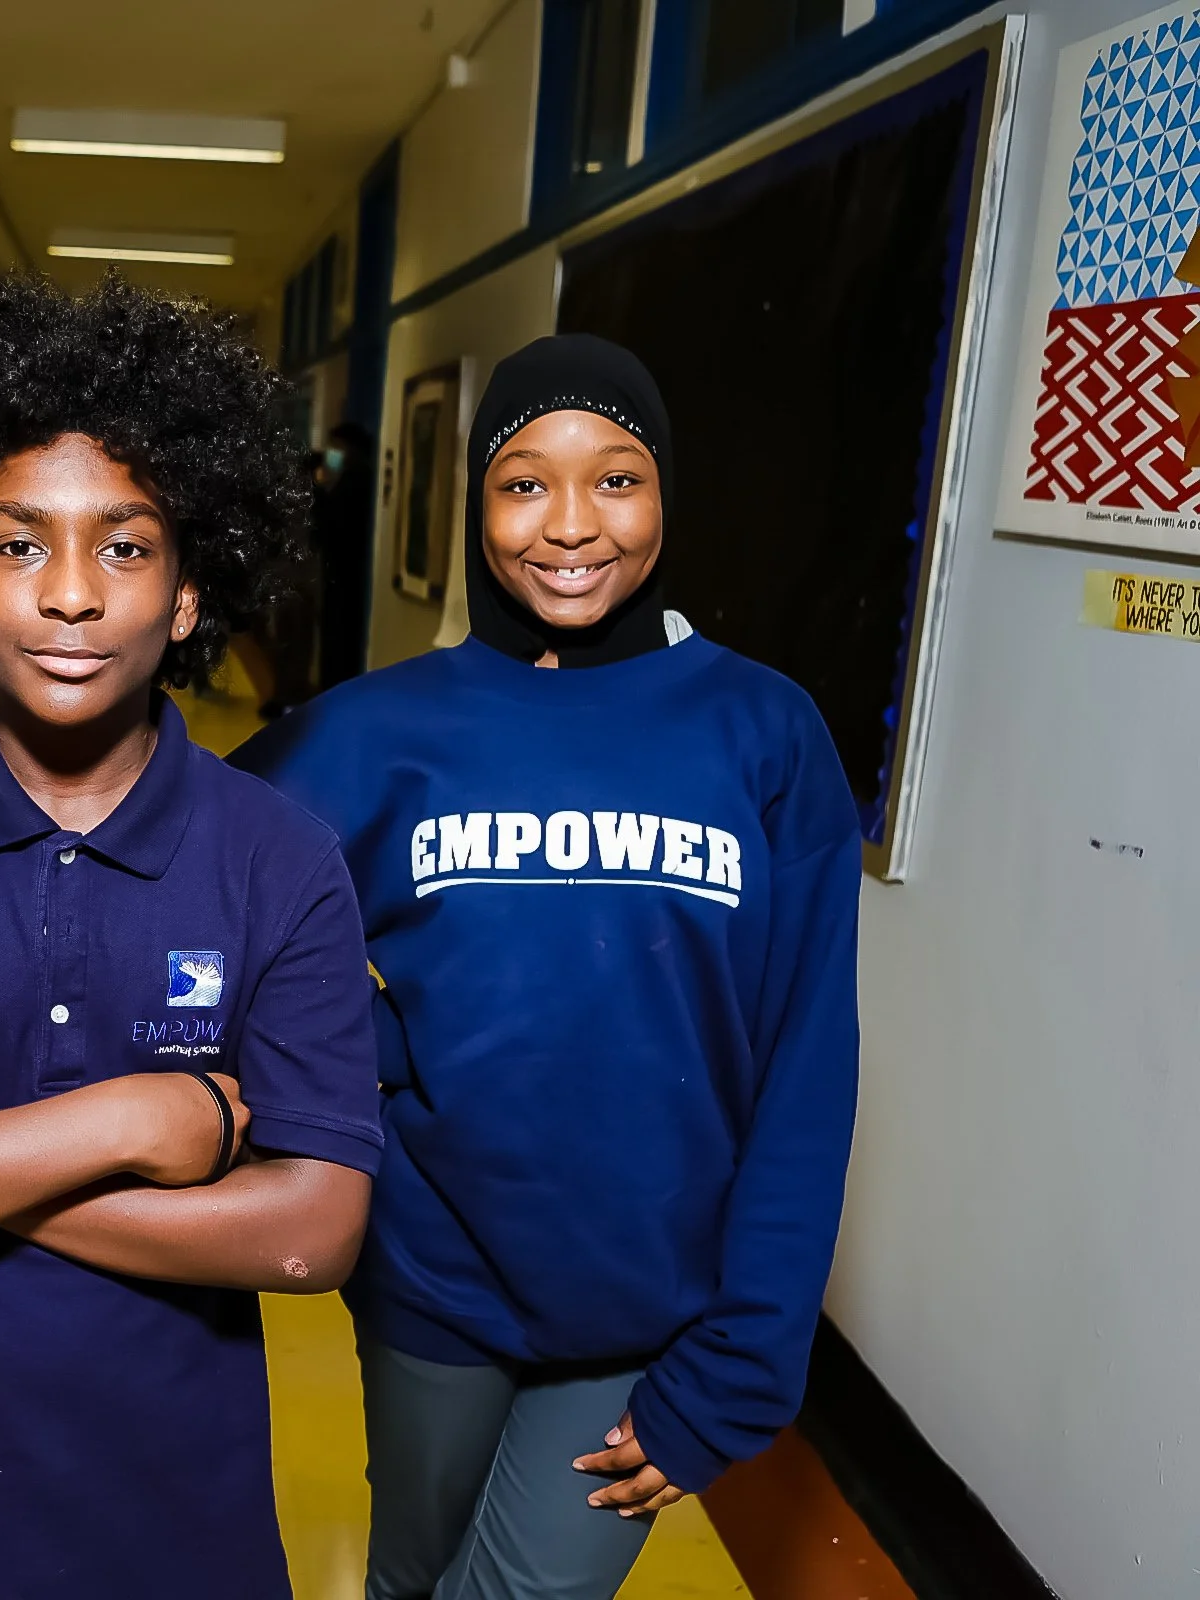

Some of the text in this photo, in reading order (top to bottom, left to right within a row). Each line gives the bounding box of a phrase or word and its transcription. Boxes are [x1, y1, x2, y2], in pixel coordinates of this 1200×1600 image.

[1177, 518, 1188, 530] Art
[1140, 580, 1185, 609] NEVER
[1192, 586, 1200, 611] T
[1126, 604, 1200, 636] WHERE YO
[411, 810, 742, 891] EMPOWER
[132, 1019, 224, 1042] EMPOW
